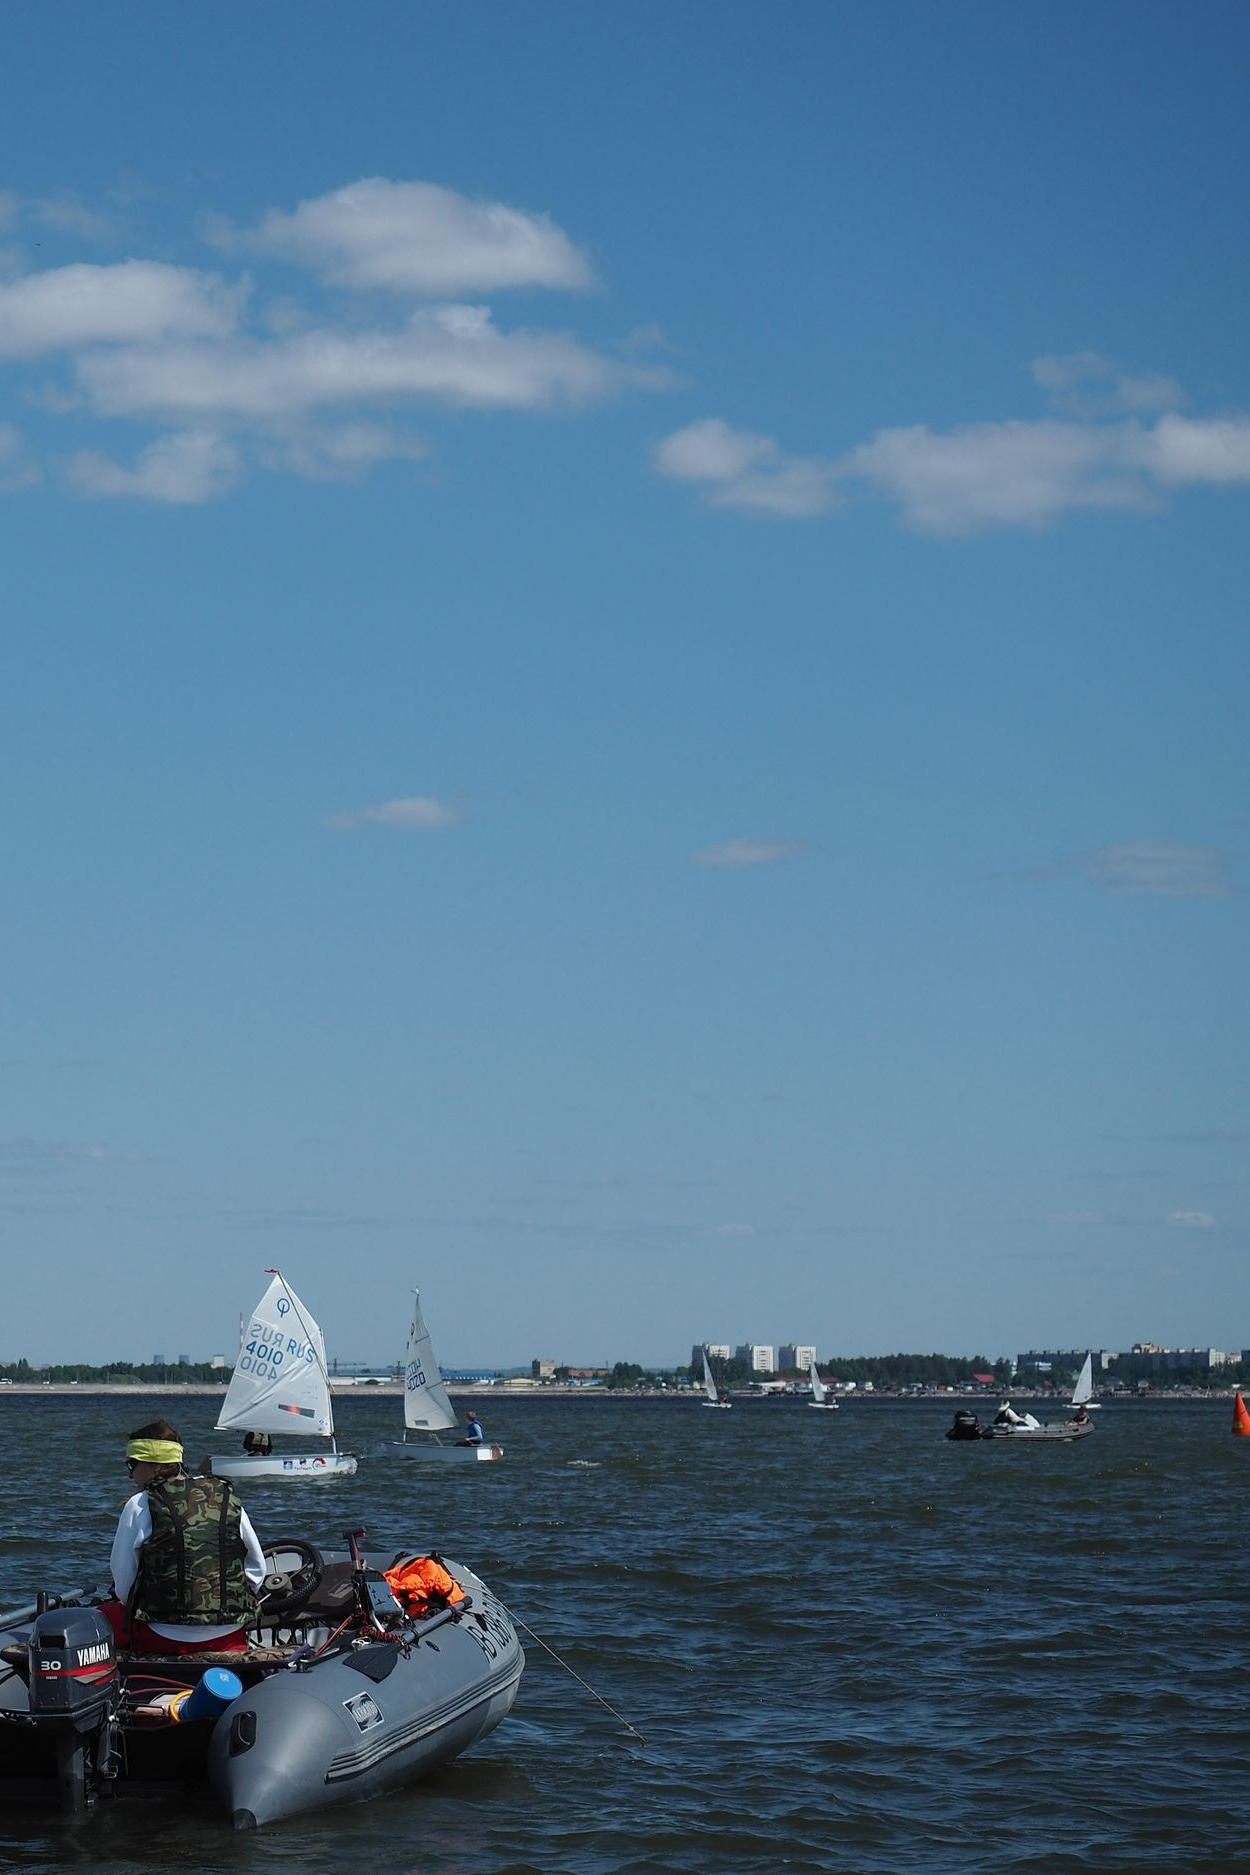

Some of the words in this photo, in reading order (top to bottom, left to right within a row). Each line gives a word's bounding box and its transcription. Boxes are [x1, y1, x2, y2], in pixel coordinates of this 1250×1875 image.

[245, 1341, 283, 1365] 4010
[286, 1338, 316, 1364] RUS
[40, 1660, 62, 1671] 30
[77, 1642, 110, 1667] YAMAHA
